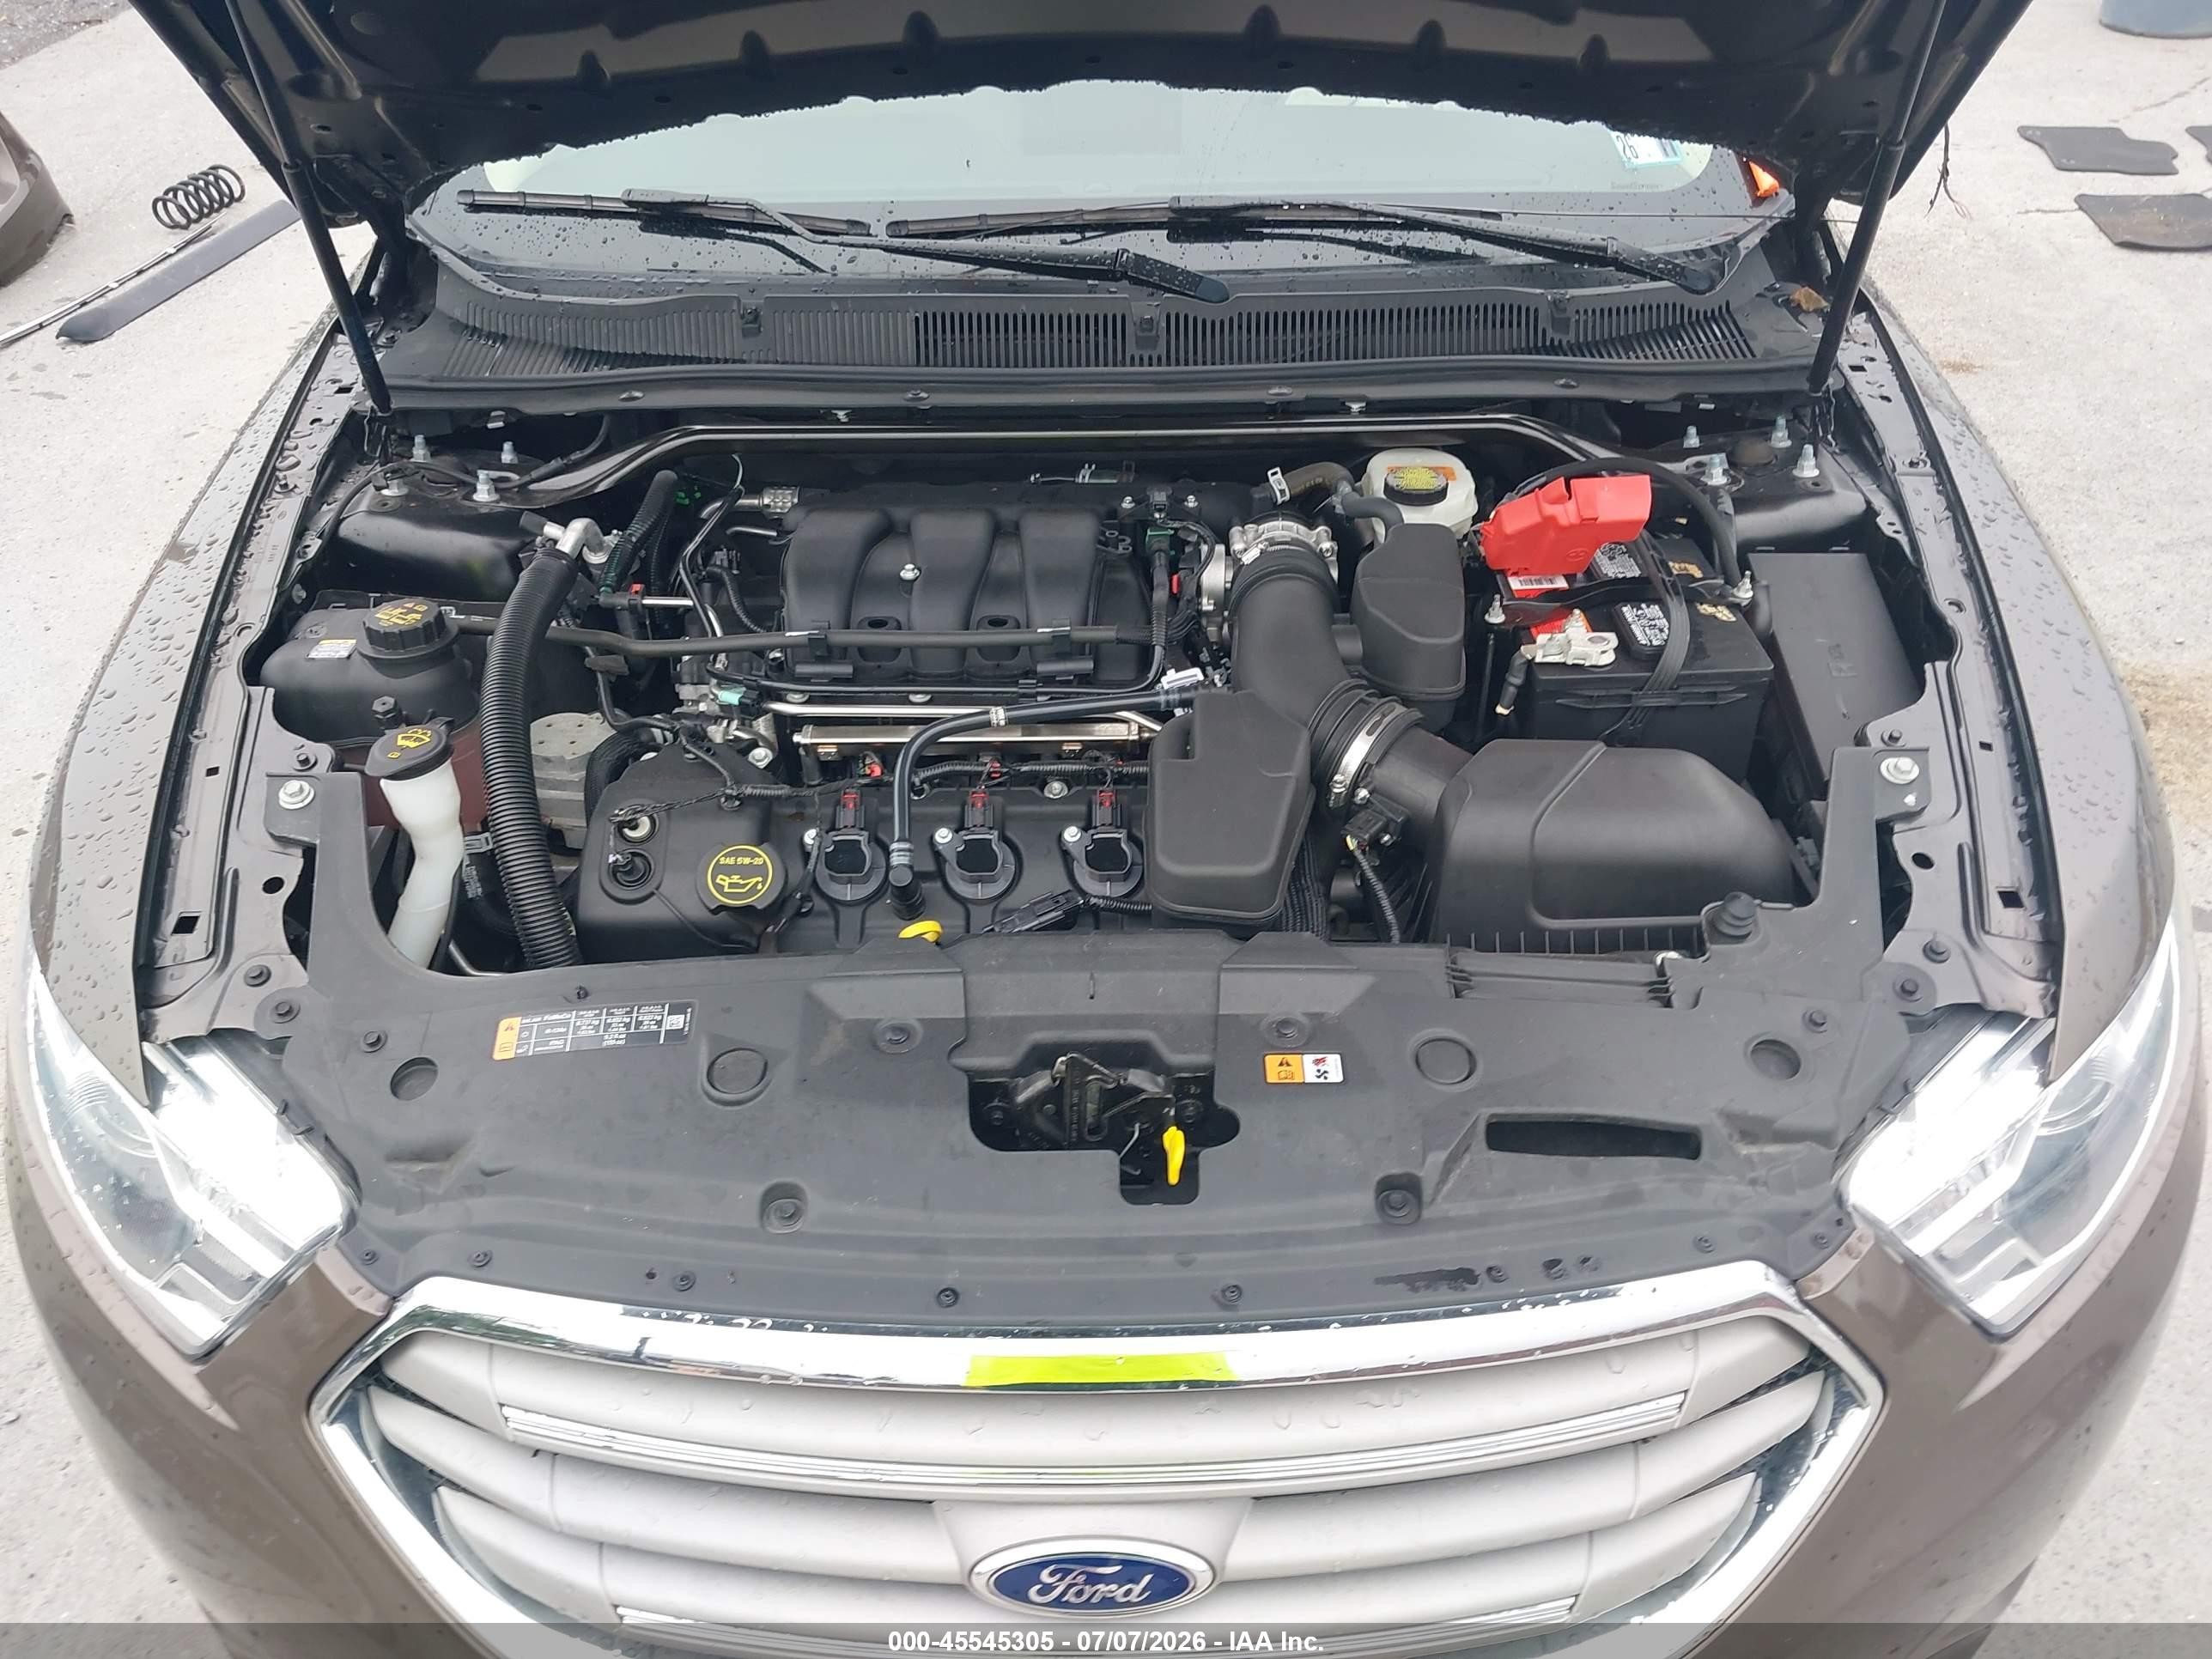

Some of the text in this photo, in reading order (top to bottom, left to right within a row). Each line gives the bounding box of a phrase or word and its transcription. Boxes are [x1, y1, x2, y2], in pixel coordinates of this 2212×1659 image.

[719, 856, 764, 866] SAE 5W-20
[1026, 1564, 1155, 1604] Ford
